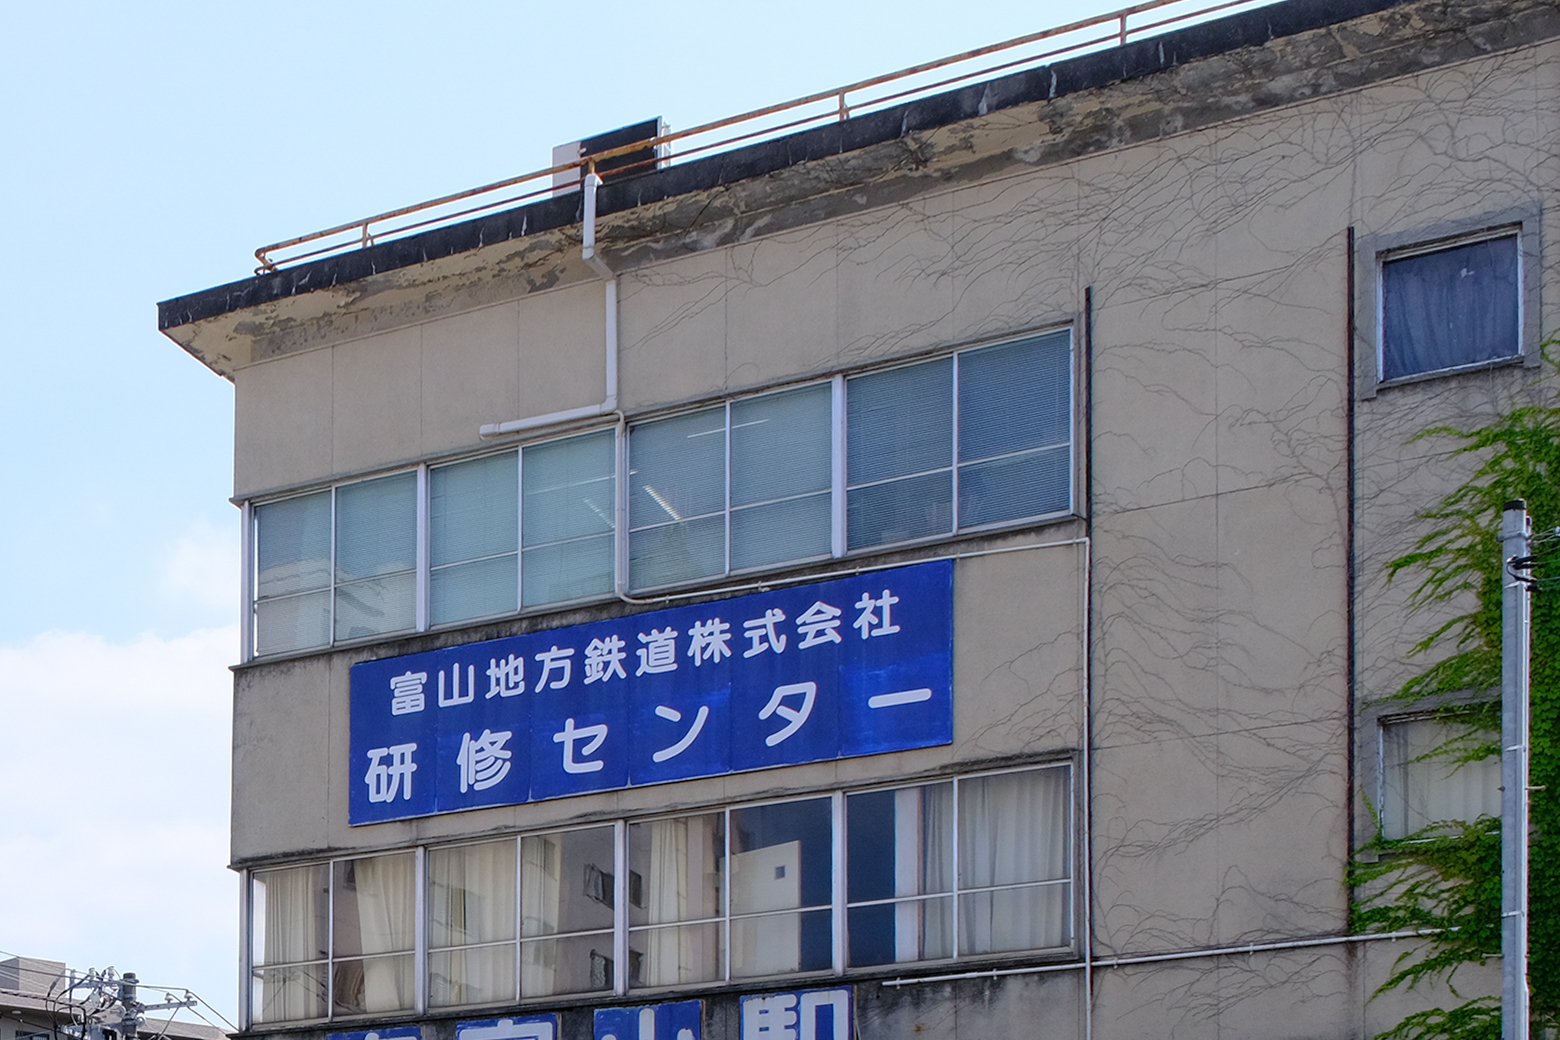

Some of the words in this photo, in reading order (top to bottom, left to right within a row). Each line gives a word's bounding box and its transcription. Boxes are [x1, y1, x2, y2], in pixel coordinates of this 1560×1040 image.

[389, 588, 901, 717] 富山地方鉄道株式会社
[363, 680, 933, 803] 研修センター
